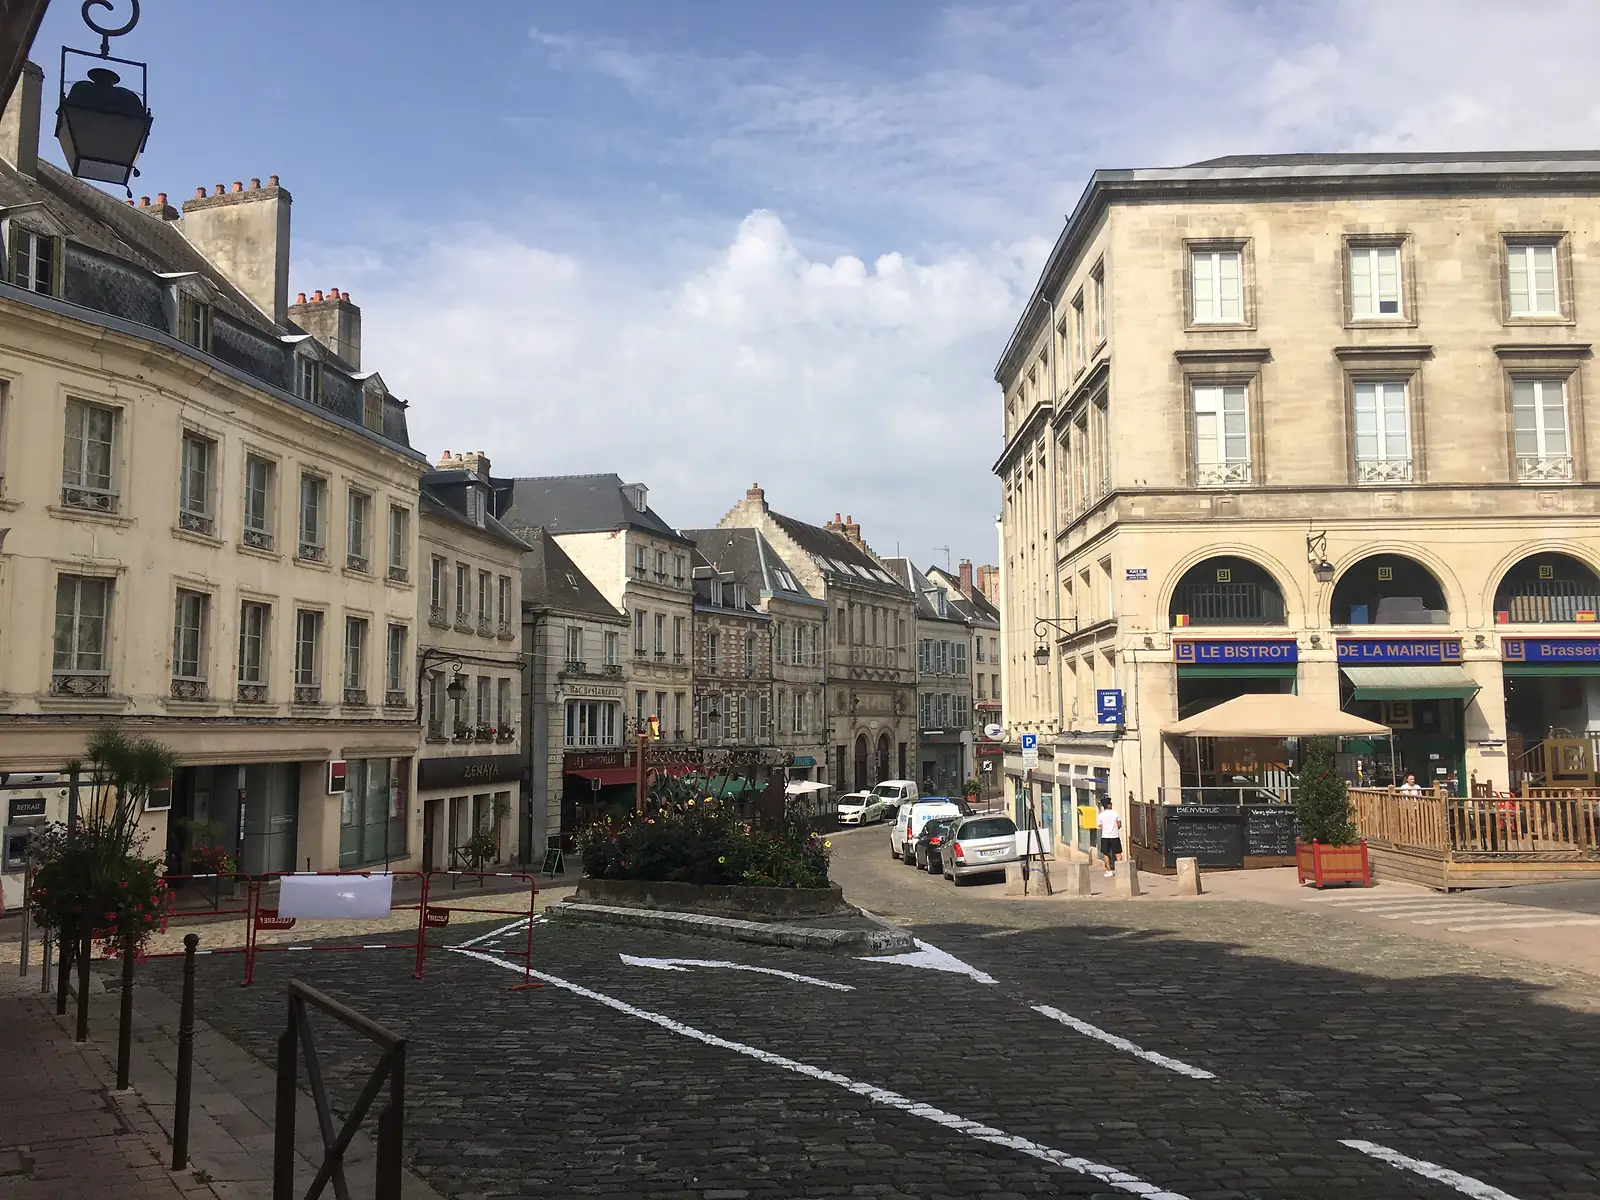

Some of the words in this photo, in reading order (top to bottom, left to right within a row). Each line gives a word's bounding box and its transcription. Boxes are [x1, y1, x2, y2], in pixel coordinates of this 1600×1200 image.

[1201, 647, 1220, 658] LE
[1225, 646, 1291, 658] BISTROT
[1338, 645, 1359, 657] DE
[1363, 645, 1383, 657] LA
[1387, 644, 1440, 657] MAIRIE
[1026, 737, 1033, 747] P
[463, 764, 499, 779] ZENAYA
[16, 803, 41, 811] RETRAIT
[1176, 806, 1220, 814] BIENVENUE
